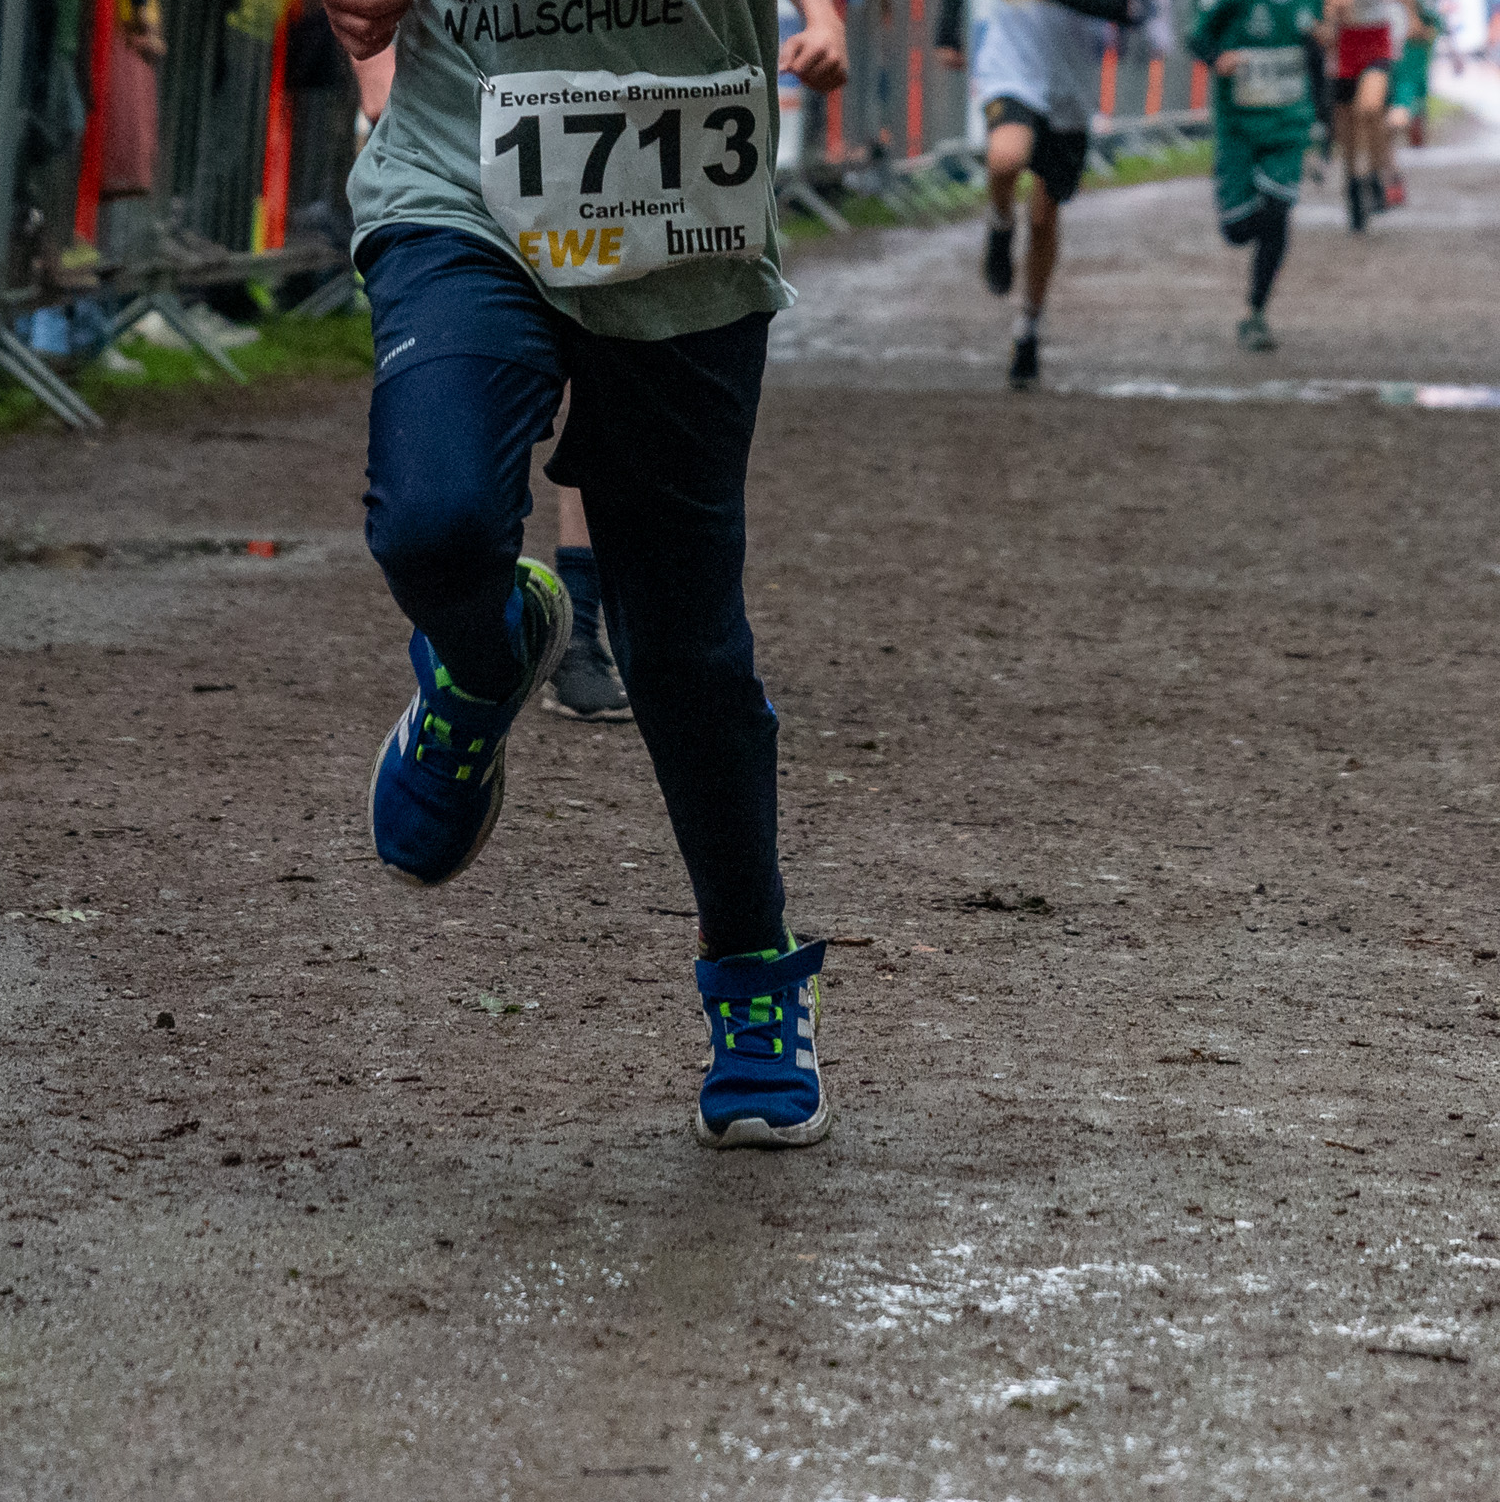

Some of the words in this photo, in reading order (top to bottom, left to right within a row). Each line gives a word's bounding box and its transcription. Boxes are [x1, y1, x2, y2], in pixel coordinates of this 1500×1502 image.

[500, 87, 622, 108] Everstener
[627, 79, 751, 102] Brunnenlauf
[494, 105, 759, 198] 1713
[579, 198, 686, 220] Carl-Henri
[518, 226, 624, 269] EWE
[665, 220, 746, 256] bruns
